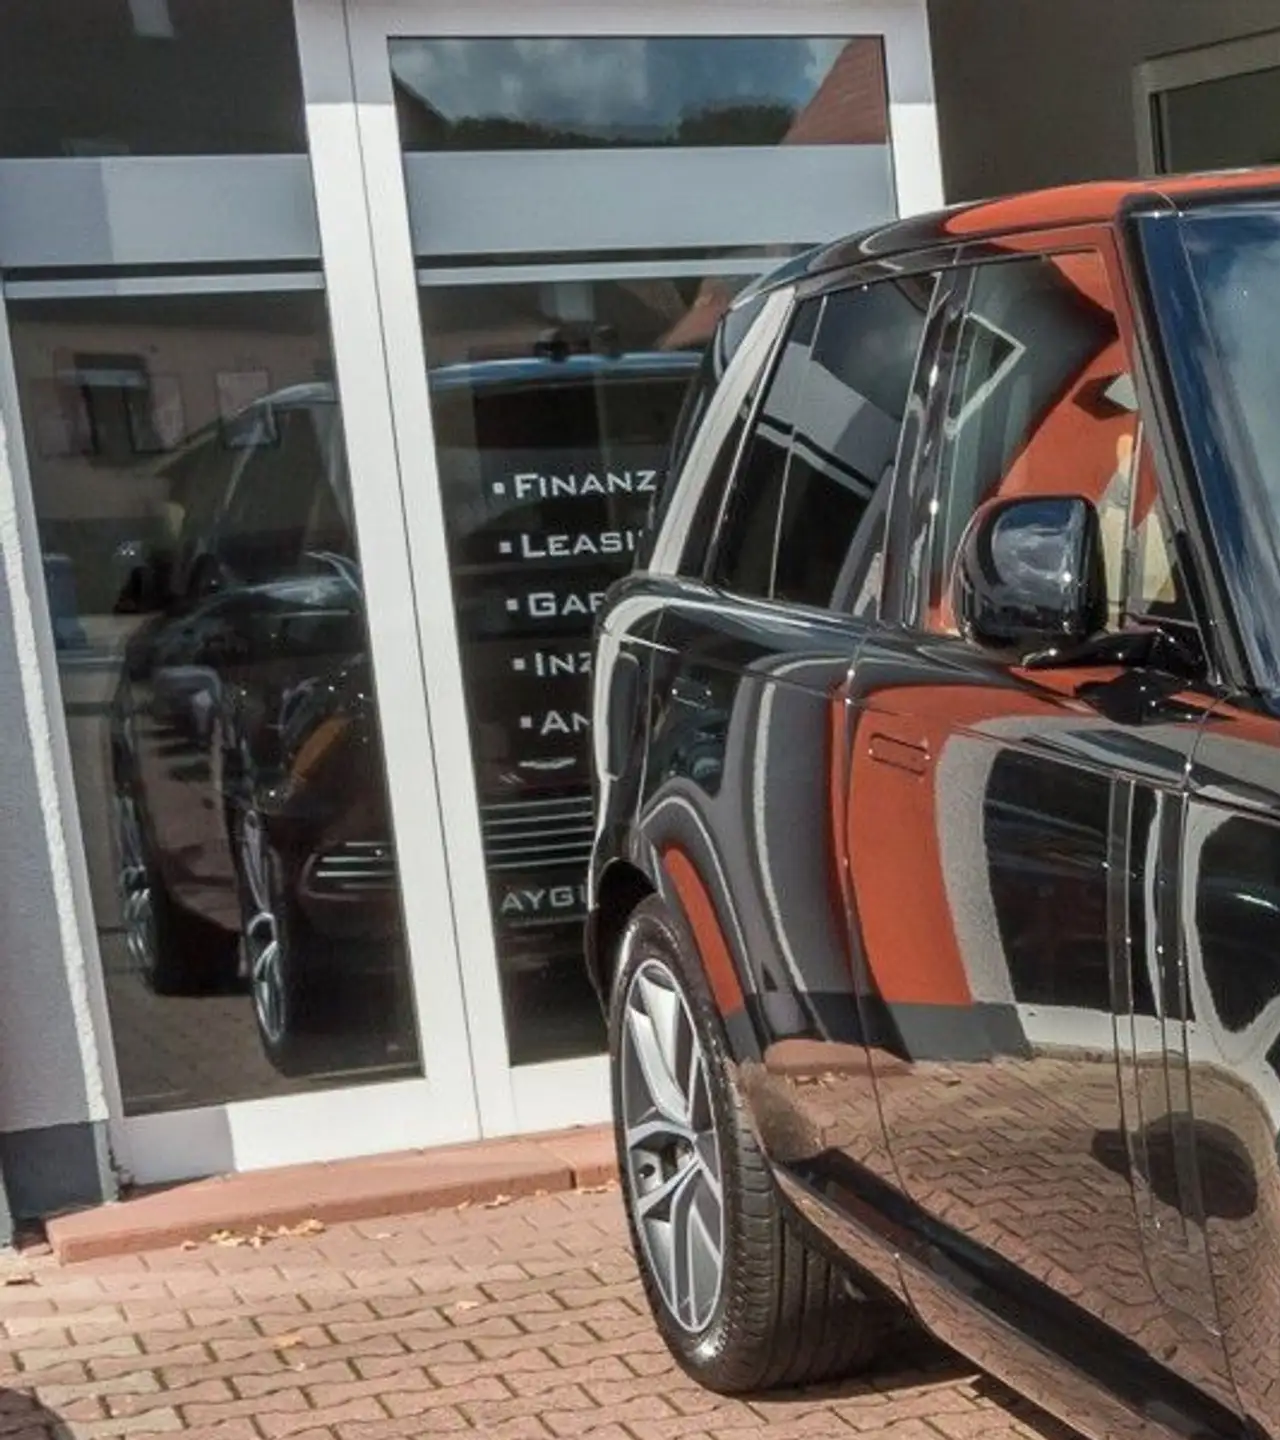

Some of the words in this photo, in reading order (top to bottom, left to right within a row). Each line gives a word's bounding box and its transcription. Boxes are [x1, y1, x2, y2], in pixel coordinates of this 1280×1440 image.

[513, 470, 657, 498] FINANZ
[520, 530, 643, 558] LEASI
[501, 884, 588, 912] AYG
